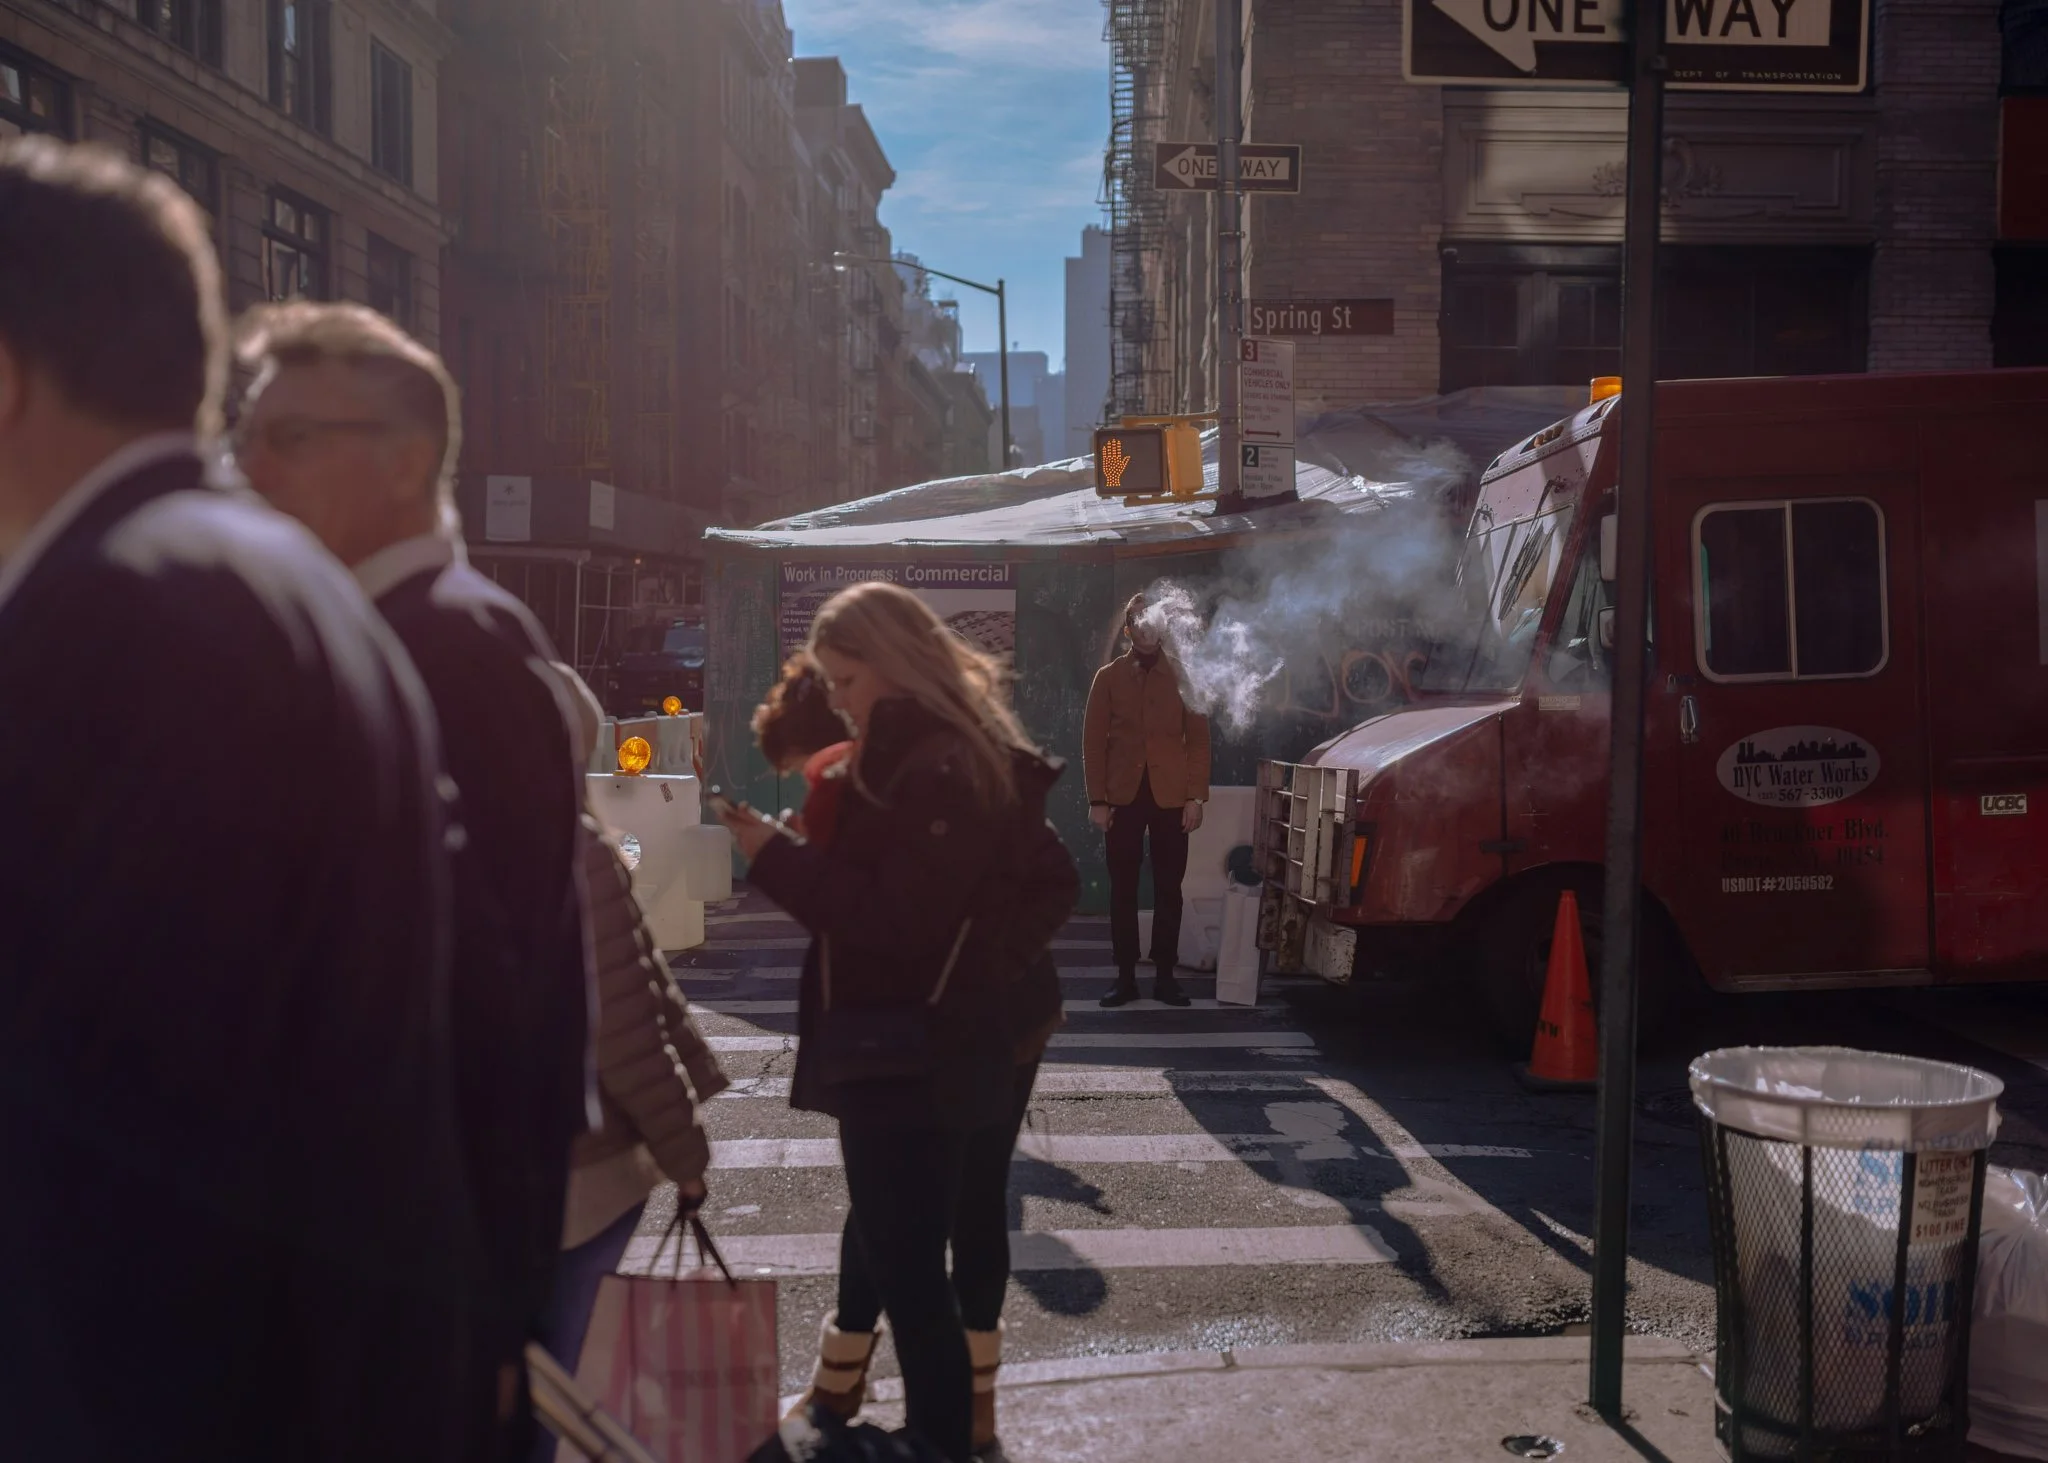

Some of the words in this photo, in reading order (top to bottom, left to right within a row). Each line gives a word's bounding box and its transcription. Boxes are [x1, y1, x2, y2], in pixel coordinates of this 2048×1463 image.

[1484, 0, 1606, 34] ONE
[1673, 0, 1793, 38] WAY
[1742, 71, 1842, 80] TRANSPORTATION
[1178, 158, 1217, 176] ONE
[1240, 158, 1280, 177] WAY
[1253, 304, 1322, 334] Spring
[1331, 306, 1352, 329] St
[1244, 341, 1254, 360] 3
[1244, 367, 1284, 378] COMMERCIAL
[1244, 379, 1273, 388] VEHICLES
[1275, 381, 1291, 390] ONLY
[1246, 447, 1255, 466] 2
[784, 566, 816, 582] Work
[820, 566, 832, 582] in
[836, 566, 899, 582] Progress:
[905, 564, 1010, 583] Commercial
[1768, 765, 1814, 786] Water
[1820, 761, 1868, 784] Works
[1778, 786, 1844, 801] 567-3300
[1984, 795, 2026, 811] UCBC
[1844, 817, 1889, 840] Blvd.
[1920, 1159, 1952, 1173] LITTER
[1916, 1223, 1941, 1238] $100
[1945, 1217, 1966, 1236] FINE
